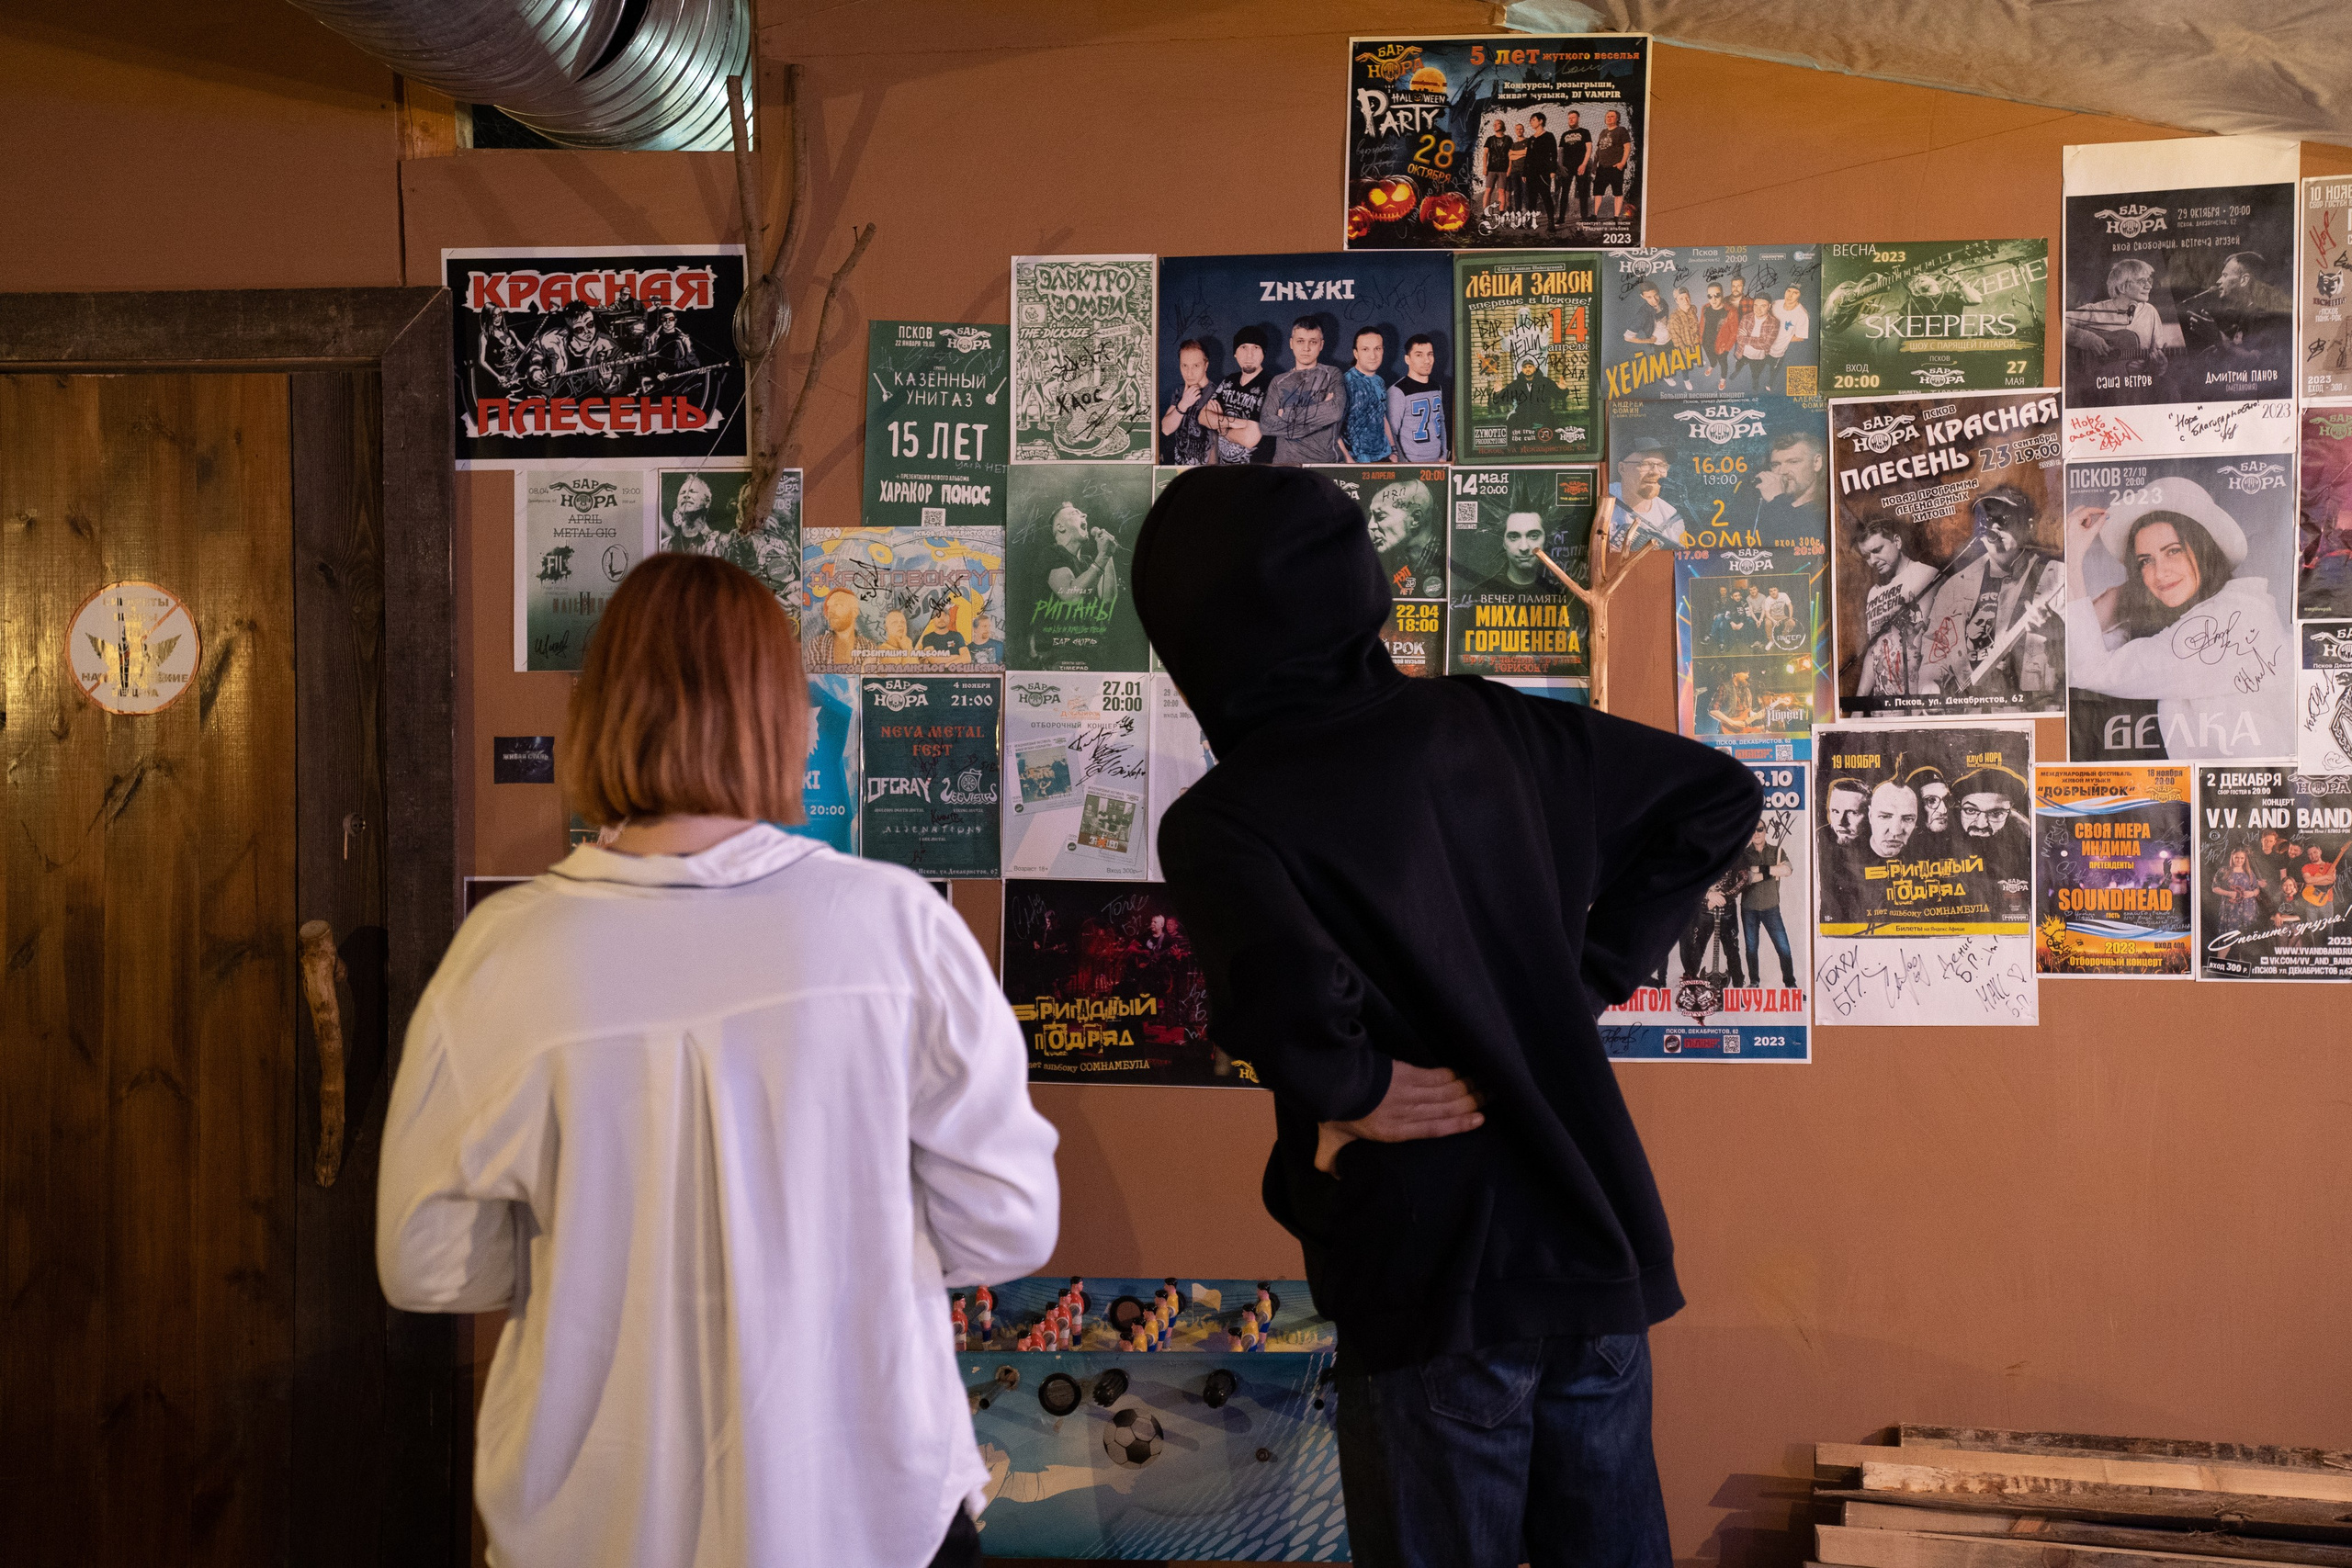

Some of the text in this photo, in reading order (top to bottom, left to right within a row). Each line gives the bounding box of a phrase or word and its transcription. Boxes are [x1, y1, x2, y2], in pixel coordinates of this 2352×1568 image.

[1470, 46, 1486, 65] 5
[1495, 50, 1540, 65] лет
[1504, 82, 1615, 90] Конкурсы, розыгрыши,
[1357, 87, 1447, 138] PARTY
[1413, 134, 1455, 168] 28
[1408, 164, 1452, 183] ОКТЯБРЯ
[2119, 204, 2148, 215] БАР
[2190, 207, 2220, 218] ОКТЯБРЯ
[1603, 233, 1632, 244] 2023
[1692, 248, 1718, 256] Псков
[1833, 243, 1876, 257] ВЕСНА
[1872, 251, 1906, 263] 2023
[1036, 268, 1131, 292] ЭЛЕКТРО
[1465, 271, 1523, 298] ЛЁША
[1531, 270, 1593, 296] ЗАКОН
[473, 273, 709, 311] КРАСНАЯ
[1469, 297, 1523, 310] впервые
[1542, 295, 1592, 305] Пскове!
[956, 327, 978, 335] БАР
[1547, 306, 1588, 344] 14
[1865, 313, 2017, 339] SKEEPERS
[899, 326, 933, 339] ПСКОВ
[1548, 344, 1589, 354] апреля
[1606, 344, 1702, 400] ХЕЙМАН
[1846, 364, 1869, 373] ВХОД
[2007, 361, 2027, 374] 27
[894, 371, 987, 389] КАЗЁННЫЙ
[1834, 375, 1880, 389] 20:00
[2005, 377, 2025, 386] МАЯ
[2308, 376, 2332, 384] 2023
[906, 390, 973, 407] УНИТАЗ
[477, 396, 707, 435] ПЛЕСЕНЬ
[1705, 405, 1742, 418] БАР
[1922, 404, 1957, 421] ПСКОВ
[2262, 402, 2291, 419] 2023
[1862, 415, 1895, 430] БАР
[1926, 398, 2060, 447] КРАСНАЯ
[1475, 428, 1506, 438] ZYMOTIC
[888, 421, 989, 461] 15 ЛЕТ
[2012, 433, 2058, 450] сентября
[1021, 451, 1048, 459] MIRROR
[1979, 443, 2013, 473] 23
[2014, 443, 2061, 464] 19:00
[1692, 457, 1748, 474] 16.06
[1840, 447, 1970, 495] ПЛЕСЕНЬ
[2123, 467, 2147, 478] 27/10
[2240, 462, 2267, 472] БАР
[1362, 470, 1396, 479] 23 АПРЕЛЯ
[1419, 469, 1445, 480] 20:00
[1479, 472, 1509, 484] мая
[2070, 468, 2121, 489] ПСКОВ
[1453, 474, 1478, 496] 14
[2125, 477, 2145, 487] 20:00
[879, 479, 991, 506] ХАРАКОР ПОНОС
[1480, 485, 1509, 495] 20:00
[1882, 479, 1979, 509] НОВАЯ ПРОГРАММА
[2109, 488, 2163, 506] 2023
[1896, 492, 1970, 516] ЛЕГЕНДАРНЫХ
[1712, 499, 1729, 527] 2
[1913, 506, 1956, 523] ХИТОВ!!!
[1679, 529, 1762, 548] ФОМЫ
[1480, 593, 1566, 604] ВЕЧЕР ПАМЯТИ
[1396, 604, 1439, 618] 22.04
[1476, 605, 1570, 627] МИХАИЛА
[1396, 619, 1439, 632] 18:00
[1393, 641, 1425, 655] РОК
[1465, 630, 1580, 652] ГОРШЕНЕВА
[851, 649, 951, 658] ПРЕЗЕНТАЦИЯ АЛЬБОМА
[885, 680, 910, 689] БАР
[1102, 681, 1141, 695] 27.01
[950, 695, 993, 707] 21:00
[1102, 697, 1142, 712] 20:00
[1894, 694, 2024, 707] Псков, Декабристов, 62
[1031, 721, 1082, 729] ОТБОРОЧНЫЙ
[928, 726, 984, 739] METAL
[2104, 711, 2262, 756] БЕЛКА
[912, 744, 953, 757] FEST
[1832, 755, 1881, 769] 19 НОЯБРЯ
[2147, 769, 2183, 778] 18 ноября
[2207, 773, 2282, 789] 2 ДЕКАБРЯ
[2262, 797, 2295, 807] КОНЦЕРТ
[810, 805, 845, 816] 20:00
[2206, 807, 2352, 829] V.V. AND BAND
[2075, 822, 2151, 839] СВОЯ МЕРА
[2082, 840, 2141, 858] ИНДИМА
[1865, 855, 1984, 880] БРИГАДНЫЙ
[2088, 861, 2134, 870] ПРЕТЕНДЕНТЫ
[1886, 879, 1967, 905] ПОДРЯД
[2058, 888, 2173, 911] SOUNDHEAD
[1889, 908, 1922, 918] альбому
[1924, 904, 1990, 917] СОМНАМБУЛА
[2327, 936, 2352, 945] 2023
[2105, 942, 2136, 954] 2023
[2069, 955, 2163, 967] Отборочный концерт
[2209, 962, 2242, 972] ВХОД 300
[2288, 966, 2338, 976] ДЕКАБРИСТОВ
[1724, 988, 1803, 1013] ШУУДАН
[1754, 1036, 1785, 1046] 2023
[1080, 1060, 1150, 1072] СОМНАМБУЛА
